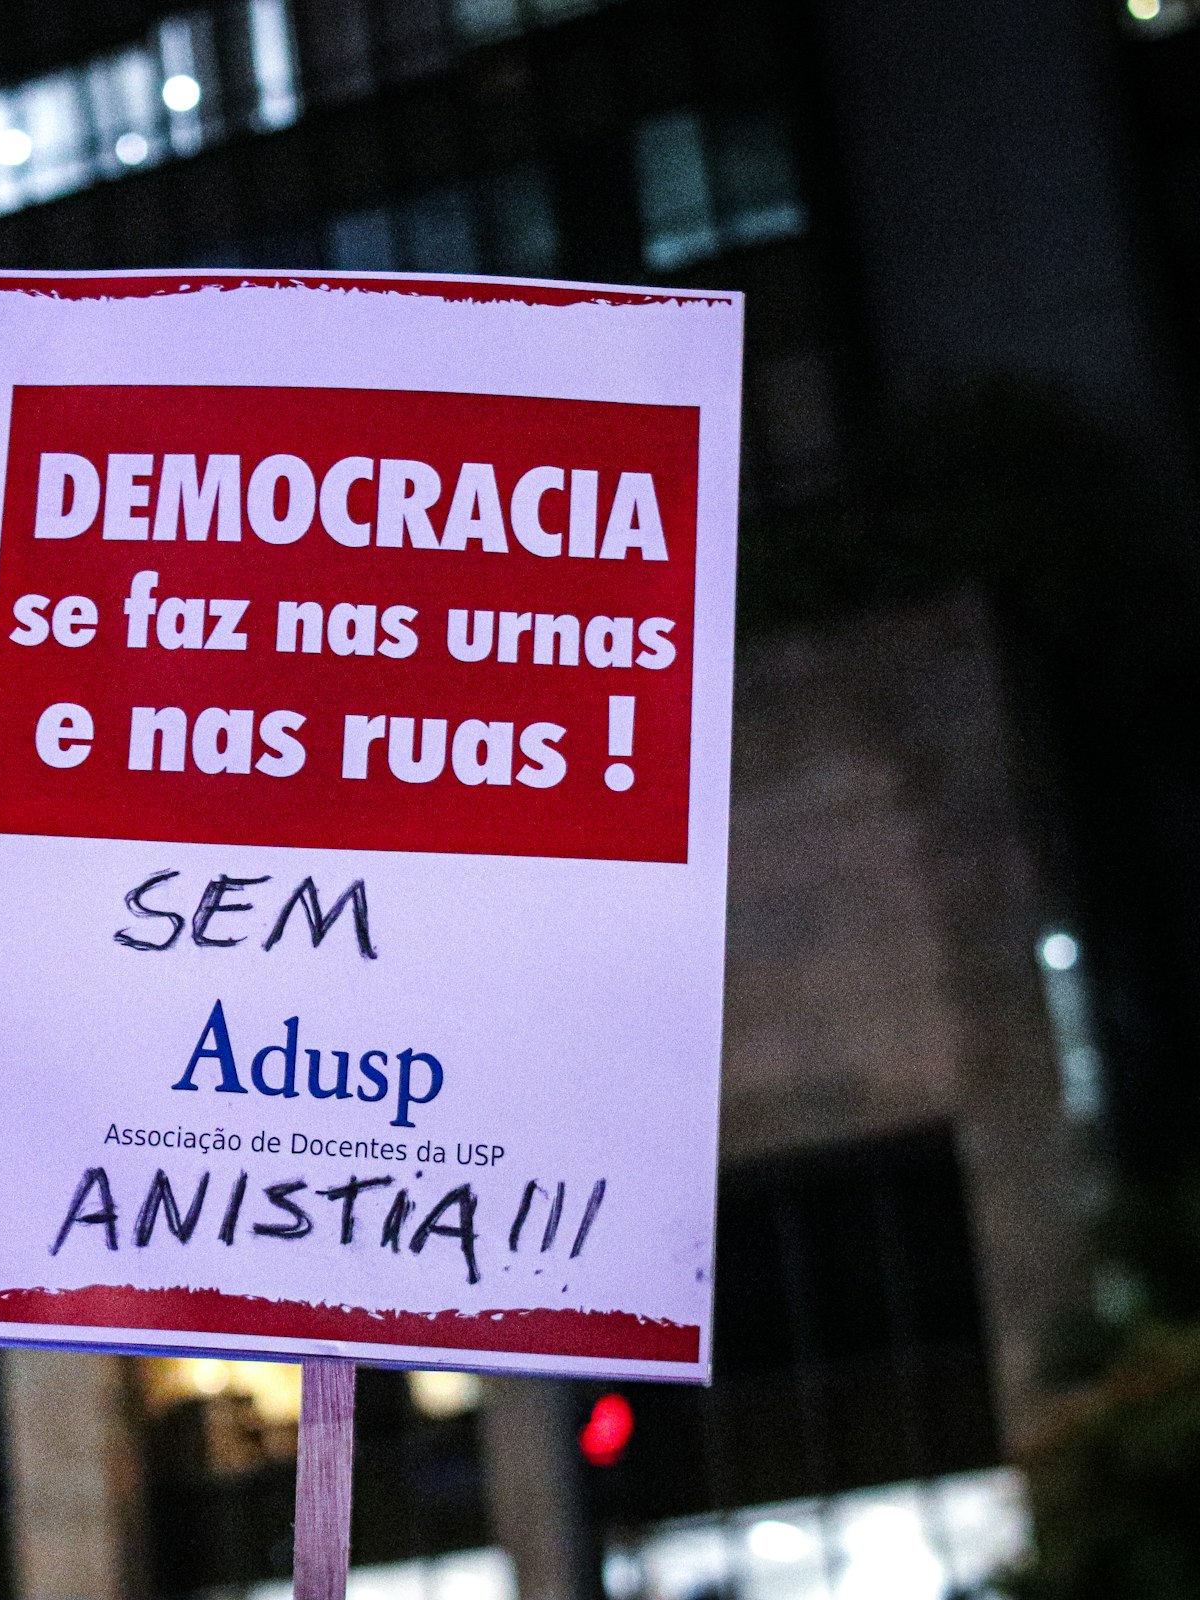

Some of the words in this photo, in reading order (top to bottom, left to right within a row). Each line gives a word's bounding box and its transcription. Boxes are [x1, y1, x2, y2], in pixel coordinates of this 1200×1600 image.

[33, 452, 669, 561] DEMOCRACIA
[9, 593, 99, 648] se
[123, 570, 251, 651] faz
[275, 599, 420, 659] nas
[446, 607, 677, 670] urnas
[35, 701, 95, 769] e
[127, 705, 308, 779] nas
[341, 714, 567, 789] ruas
[113, 868, 379, 960] SEM
[171, 997, 445, 1128] Adusp
[104, 1122, 242, 1154] Associação
[251, 1129, 282, 1155] de
[291, 1132, 408, 1163] Docentes
[416, 1139, 448, 1165] da
[456, 1143, 505, 1168] USP
